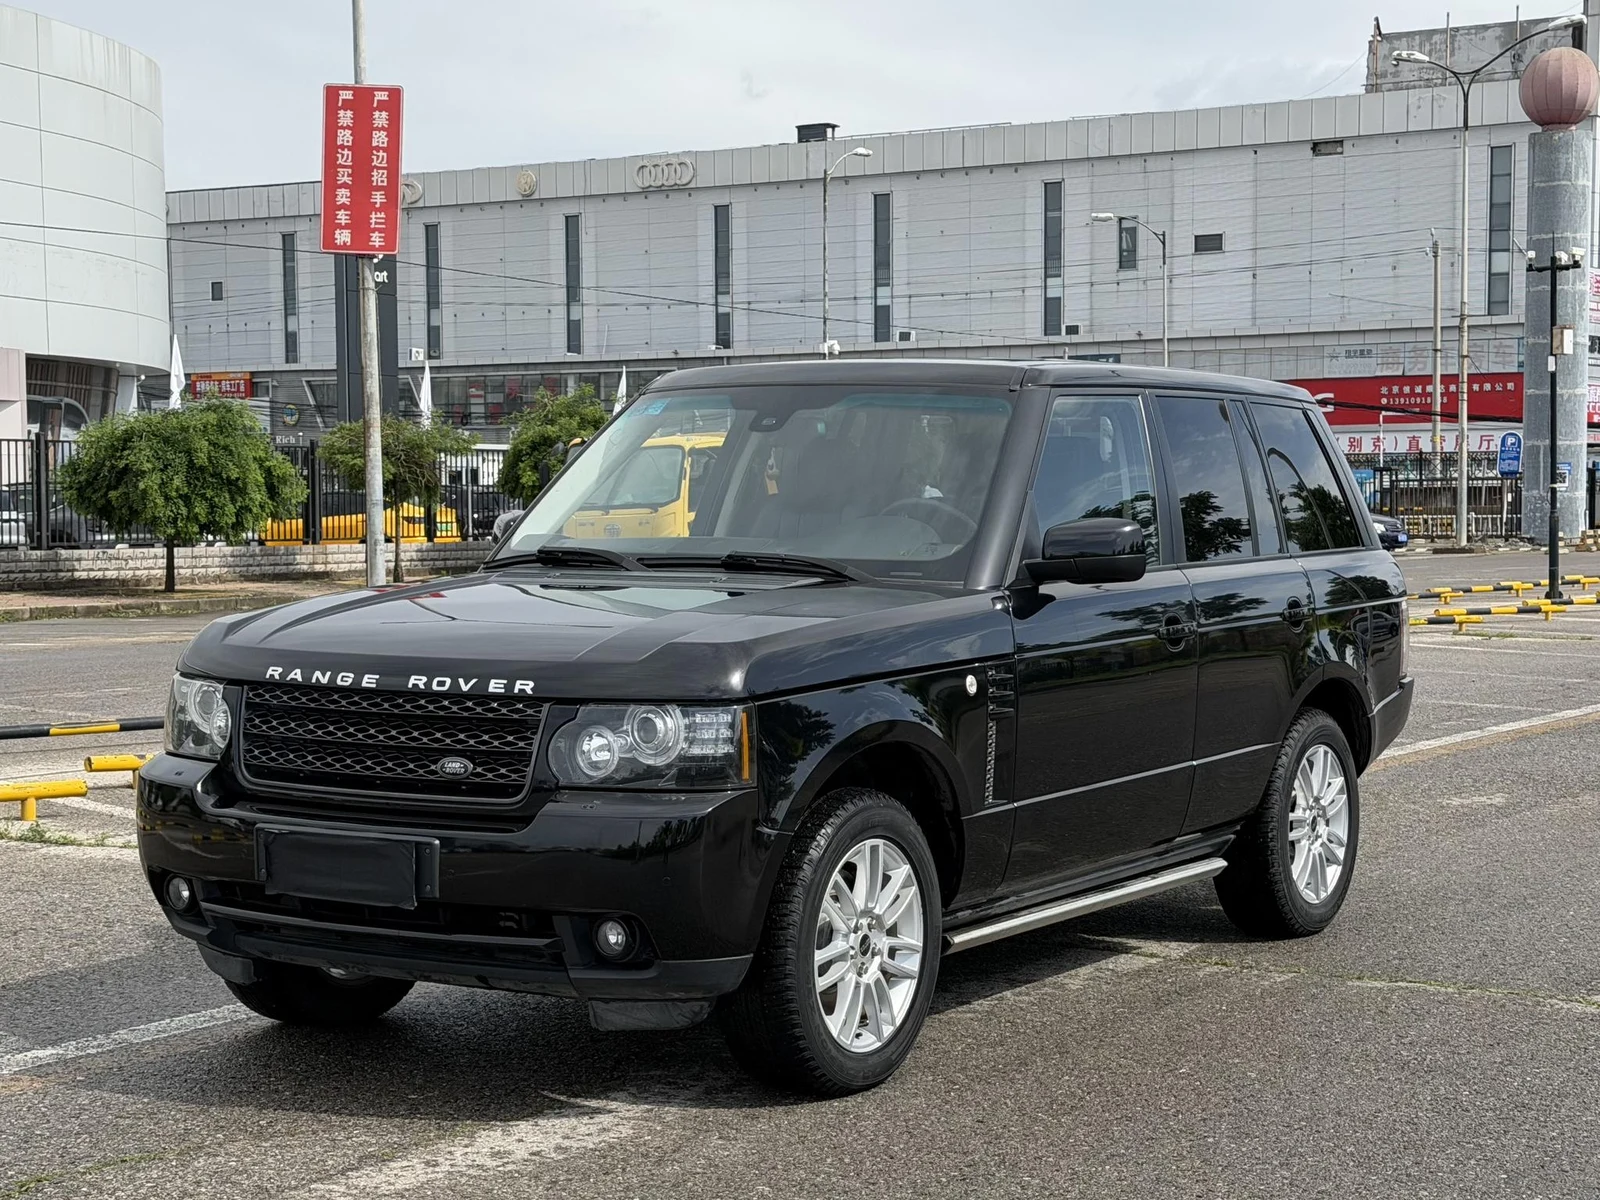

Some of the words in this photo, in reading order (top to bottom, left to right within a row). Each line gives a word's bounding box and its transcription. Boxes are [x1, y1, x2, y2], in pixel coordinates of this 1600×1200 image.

[334, 90, 354, 246] 严禁路边买卖车辆
[368, 91, 389, 249] 严禁路边招手拦车
[374, 270, 389, 283] art
[1380, 382, 1515, 395] 北京信诚顺达商有限公司
[1389, 396, 1448, 405] 139109188
[275, 435, 296, 444] Rich
[1507, 437, 1516, 446] P
[265, 666, 380, 688] RANGE
[407, 675, 535, 694] ROVER
